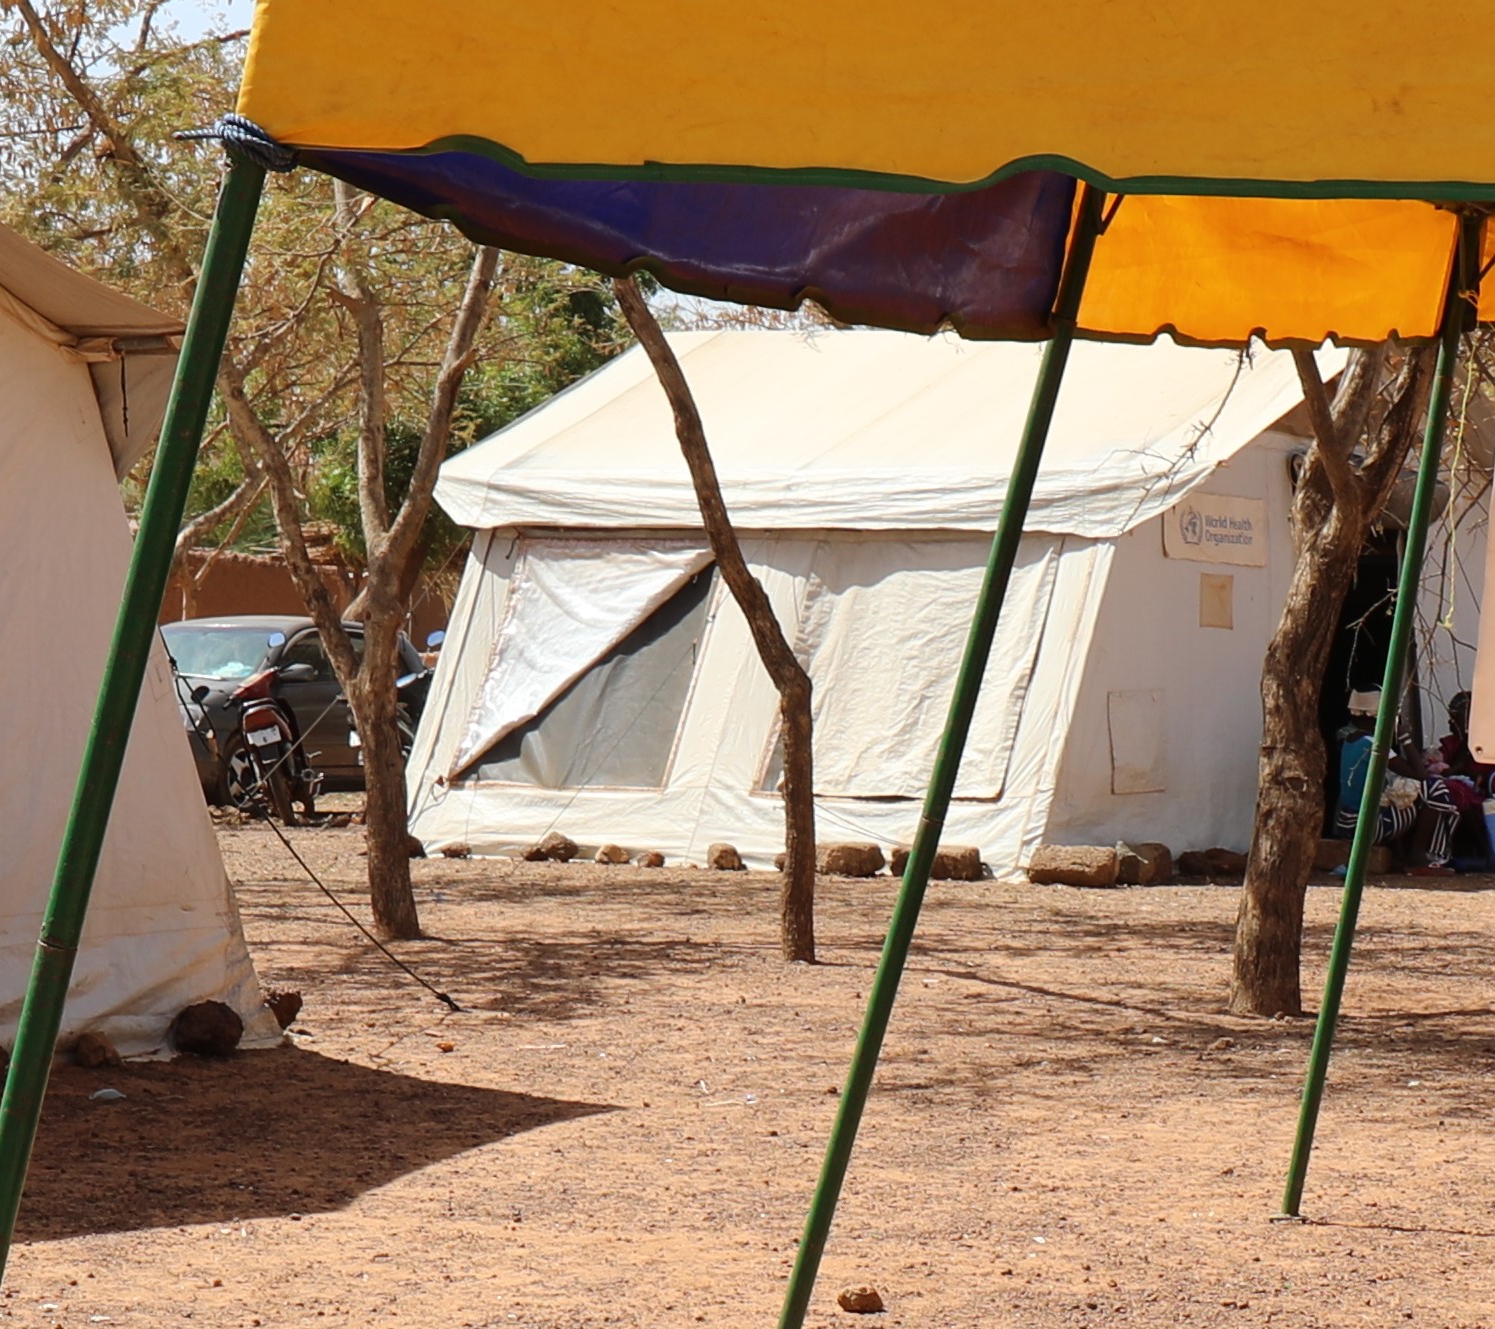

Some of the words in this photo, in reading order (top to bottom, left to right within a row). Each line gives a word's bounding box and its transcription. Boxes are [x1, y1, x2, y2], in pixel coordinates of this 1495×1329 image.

[1204, 515, 1228, 529] World
[1229, 516, 1252, 531] Health
[1205, 530, 1253, 546] Organization
